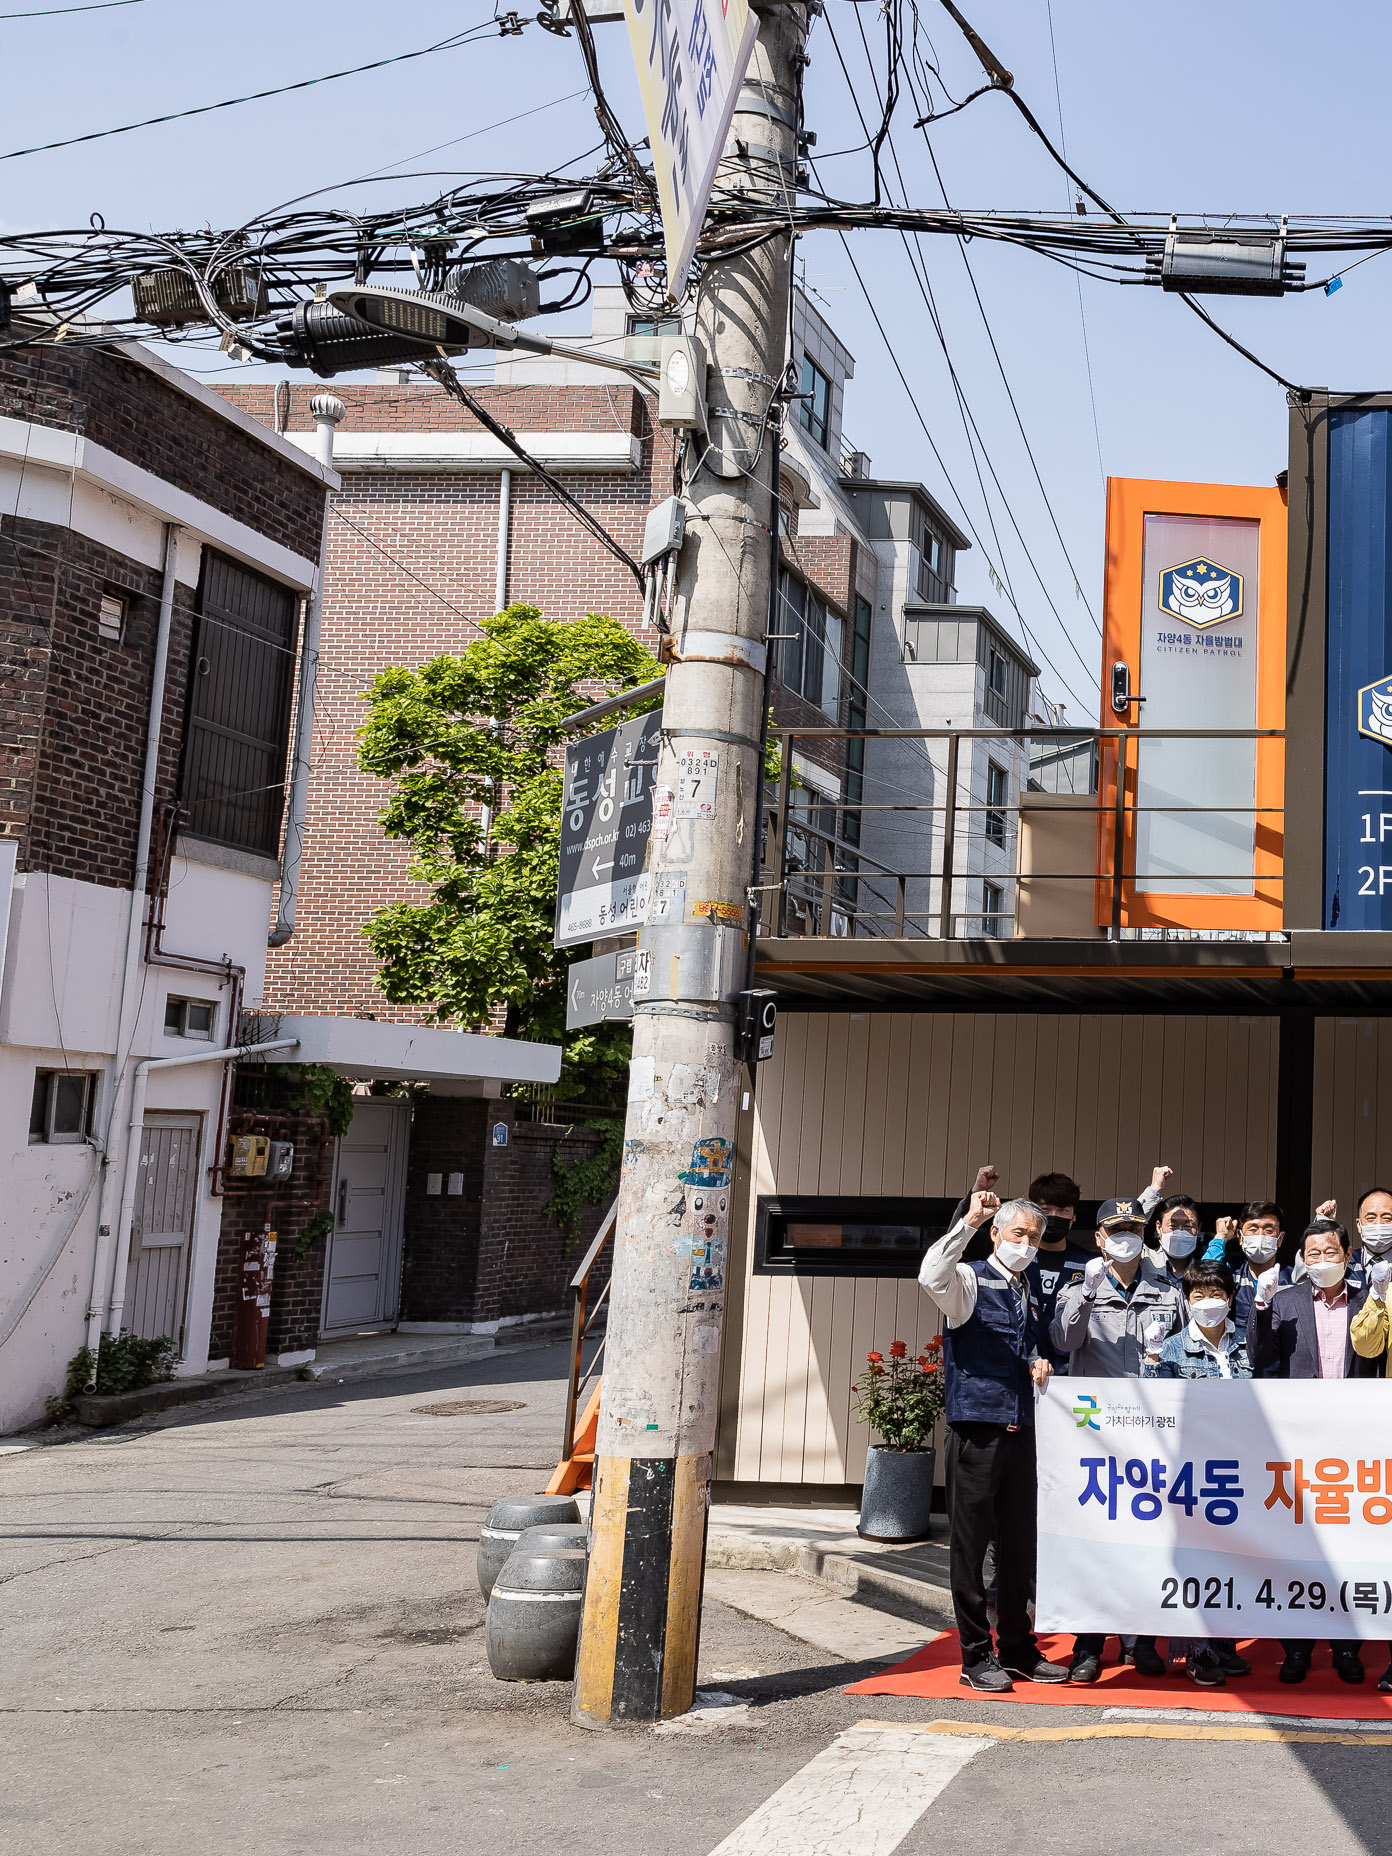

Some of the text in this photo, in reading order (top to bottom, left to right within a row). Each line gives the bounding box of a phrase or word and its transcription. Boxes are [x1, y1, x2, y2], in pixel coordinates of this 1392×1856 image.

[1157, 632, 1243, 648] 자양4동 자율방범대
[1157, 646, 1198, 654] CITIZEN
[680, 758, 718, 768] 0324D
[687, 766, 708, 776] 891
[565, 750, 658, 832] 동성교
[691, 779, 702, 798] 7
[625, 822, 637, 838] 02)
[566, 828, 620, 855] www.dspch.or.kr
[619, 853, 636, 868] 40m
[660, 900, 668, 914] 7
[590, 984, 623, 1014] 자양4동
[1105, 1415, 1176, 1429] 가치더하기 광진
[1078, 1455, 1245, 1526] 자양4동
[1160, 1575, 1242, 1611] 2021.
[1254, 1577, 1392, 1615] 4.29.(목)
